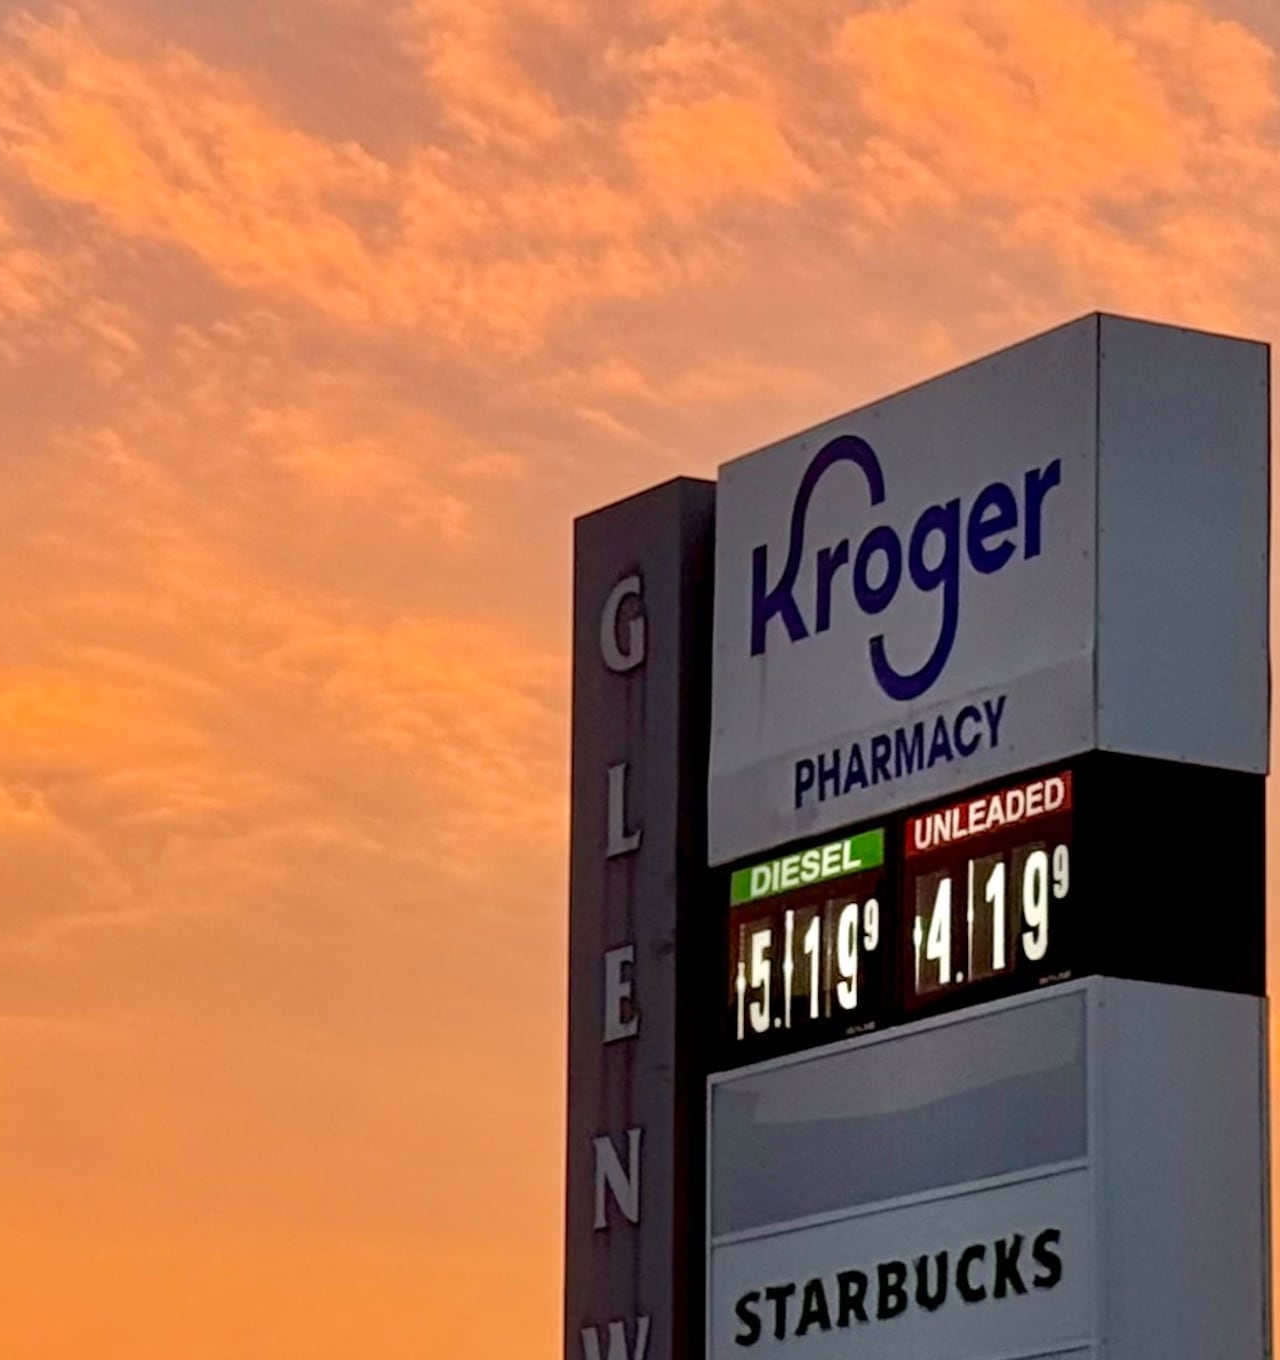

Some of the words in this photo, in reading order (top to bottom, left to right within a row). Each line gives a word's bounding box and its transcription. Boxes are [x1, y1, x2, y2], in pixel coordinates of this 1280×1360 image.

[750, 434, 1061, 701] Kroger
[794, 696, 1006, 809] PHARMACY
[750, 839, 862, 899] DIESEL
[913, 776, 1066, 850] UNLEADED
[735, 1229, 1062, 1346] STARBUCKS
